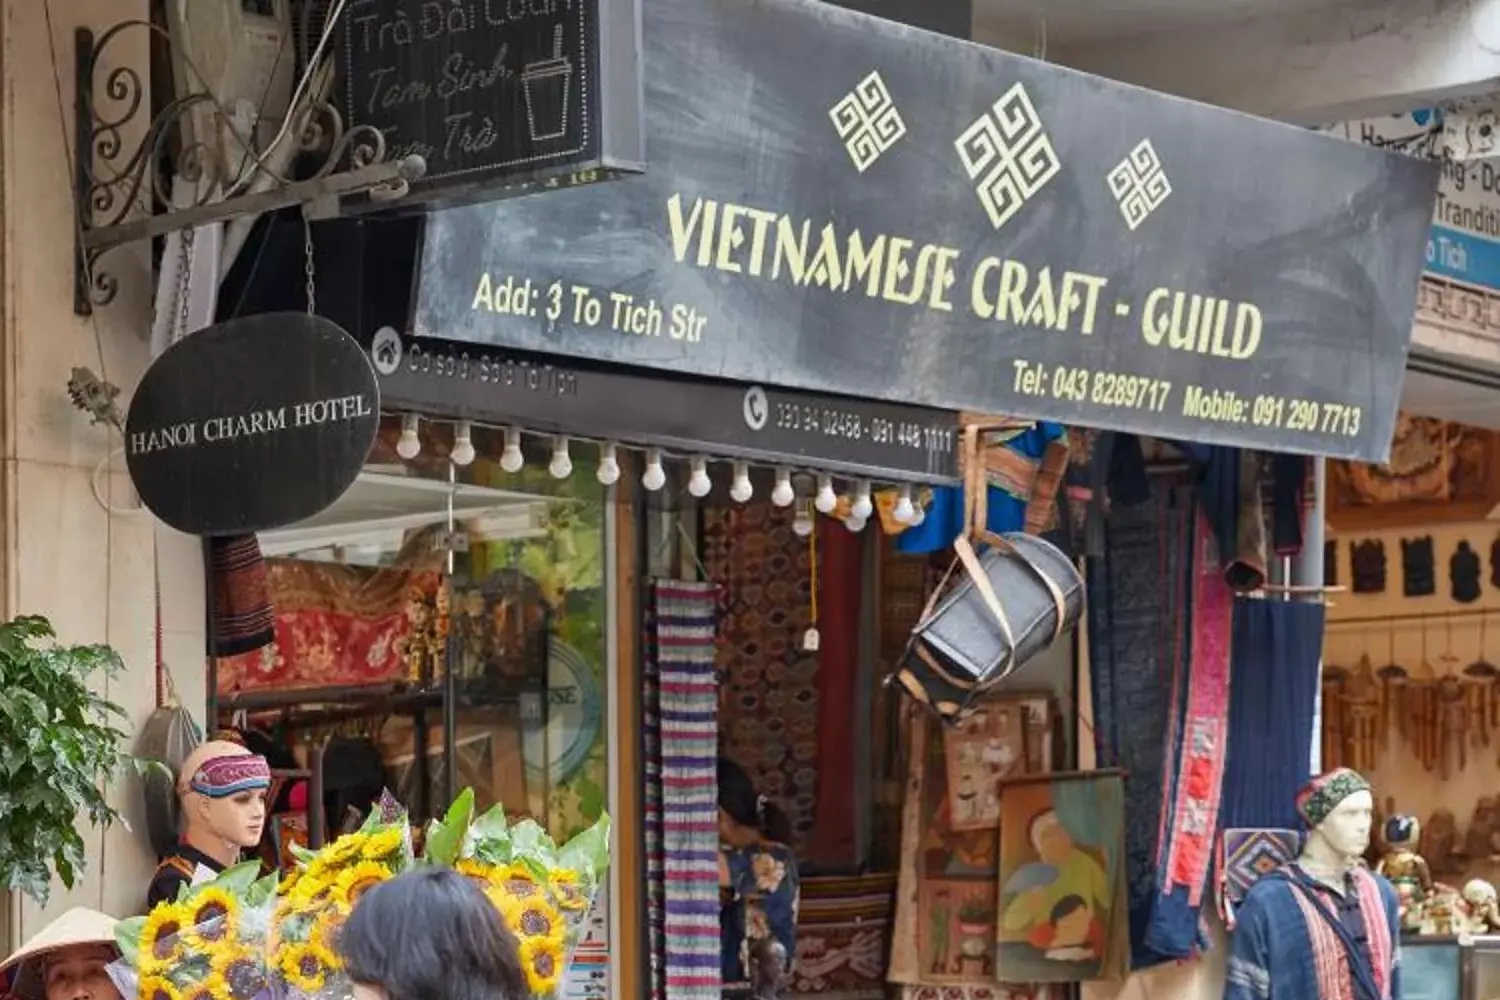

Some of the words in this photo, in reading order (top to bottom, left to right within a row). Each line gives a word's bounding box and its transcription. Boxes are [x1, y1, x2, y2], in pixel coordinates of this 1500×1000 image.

[471, 272, 539, 318] Add:
[571, 285, 602, 327] To
[609, 291, 663, 337] Tich
[668, 303, 708, 343] Str
[667, 191, 961, 312] VIETNAMESE
[970, 255, 1108, 335] CRAFT
[1115, 302, 1131, 316] -
[1141, 286, 1264, 360] GUILD
[131, 422, 197, 454] HANOI
[203, 407, 286, 442] CHARM
[293, 394, 372, 427] HOTEL
[1012, 360, 1048, 396] Tel:
[1052, 366, 1089, 402] 043
[1091, 371, 1171, 413] 8289717
[1182, 384, 1249, 424] Mobile:
[1252, 394, 1283, 428] 091
[1287, 398, 1319, 433] 290
[1320, 403, 1361, 438] 7713
